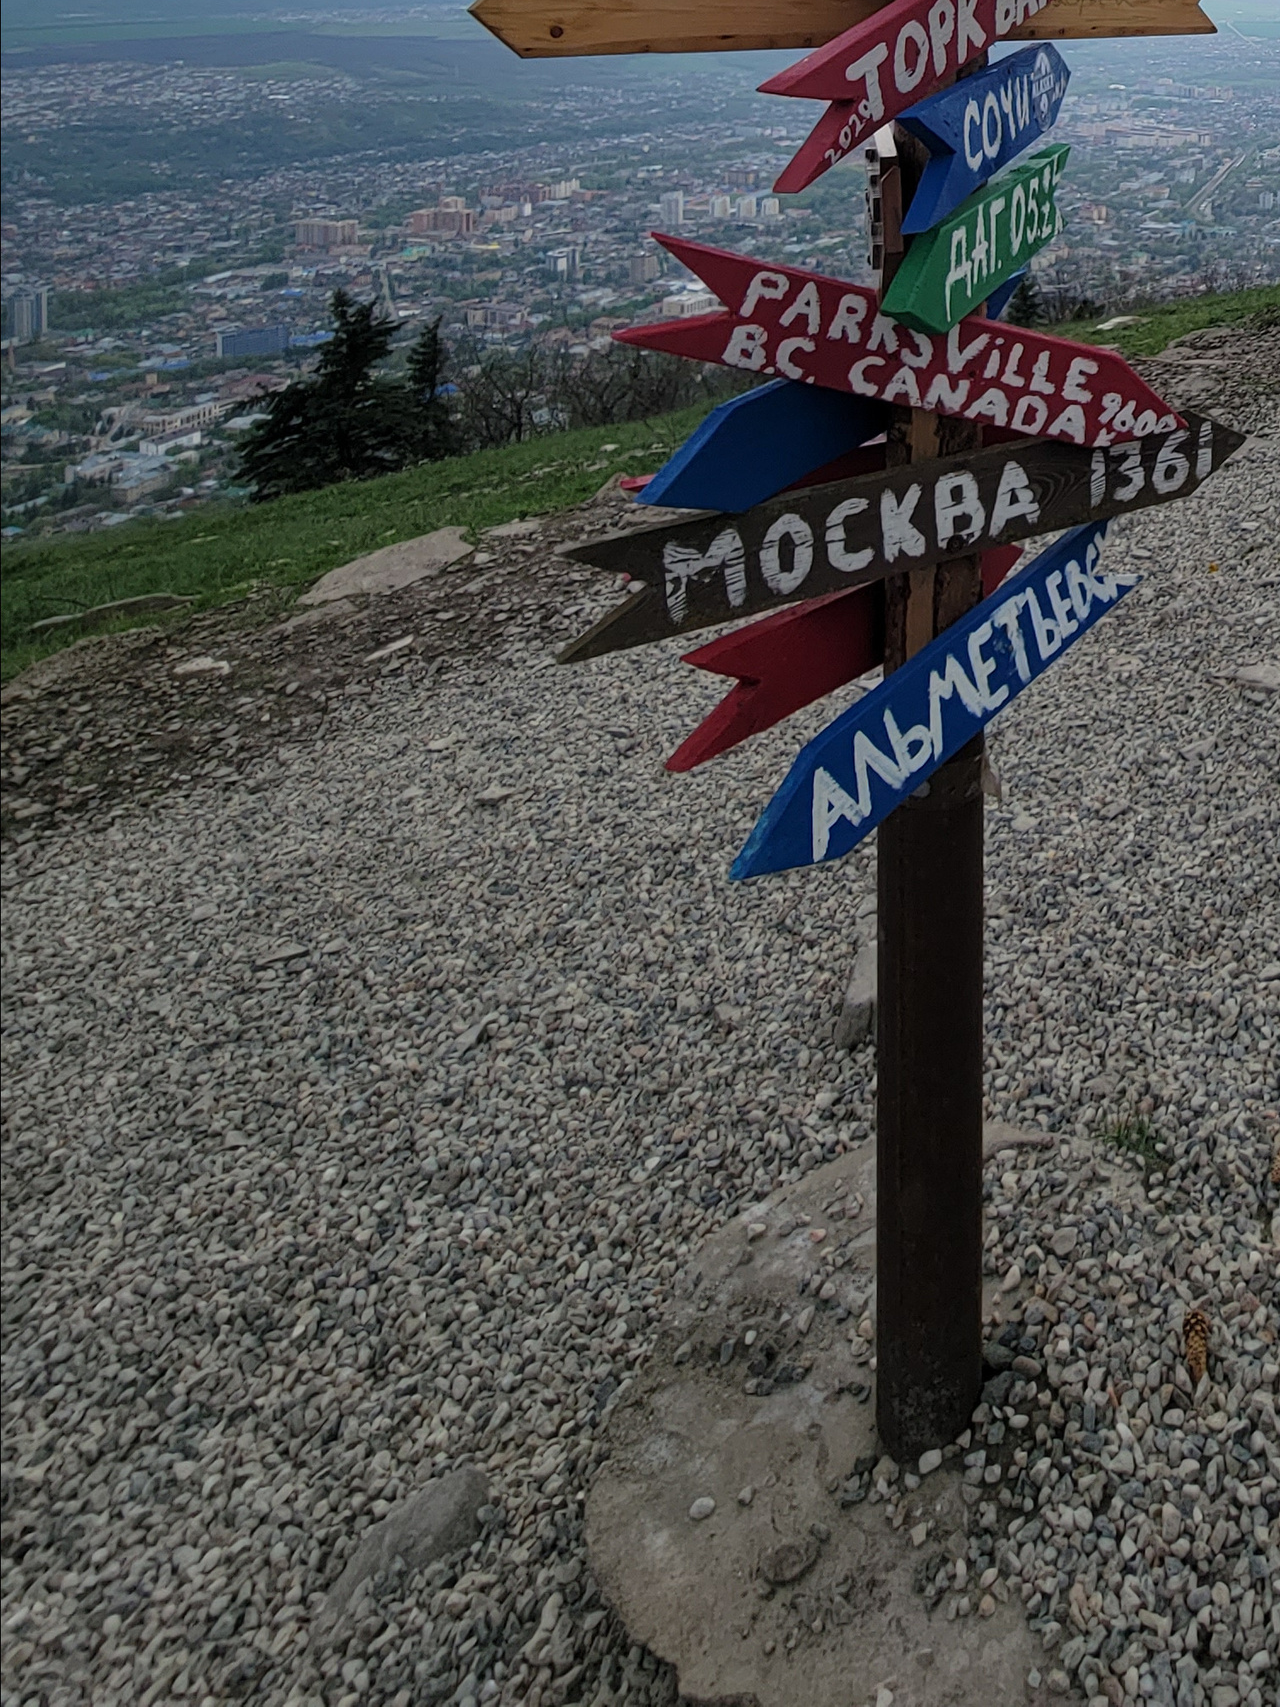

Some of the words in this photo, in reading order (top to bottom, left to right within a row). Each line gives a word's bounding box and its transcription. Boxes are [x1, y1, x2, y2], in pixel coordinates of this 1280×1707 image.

[964, 74, 1030, 172] СОЧИ
[848, 355, 1086, 444] CANADA
[1098, 392, 1177, 437] 9600
[664, 460, 1040, 624] МОСКВА
[1090, 420, 1213, 509] 1361
